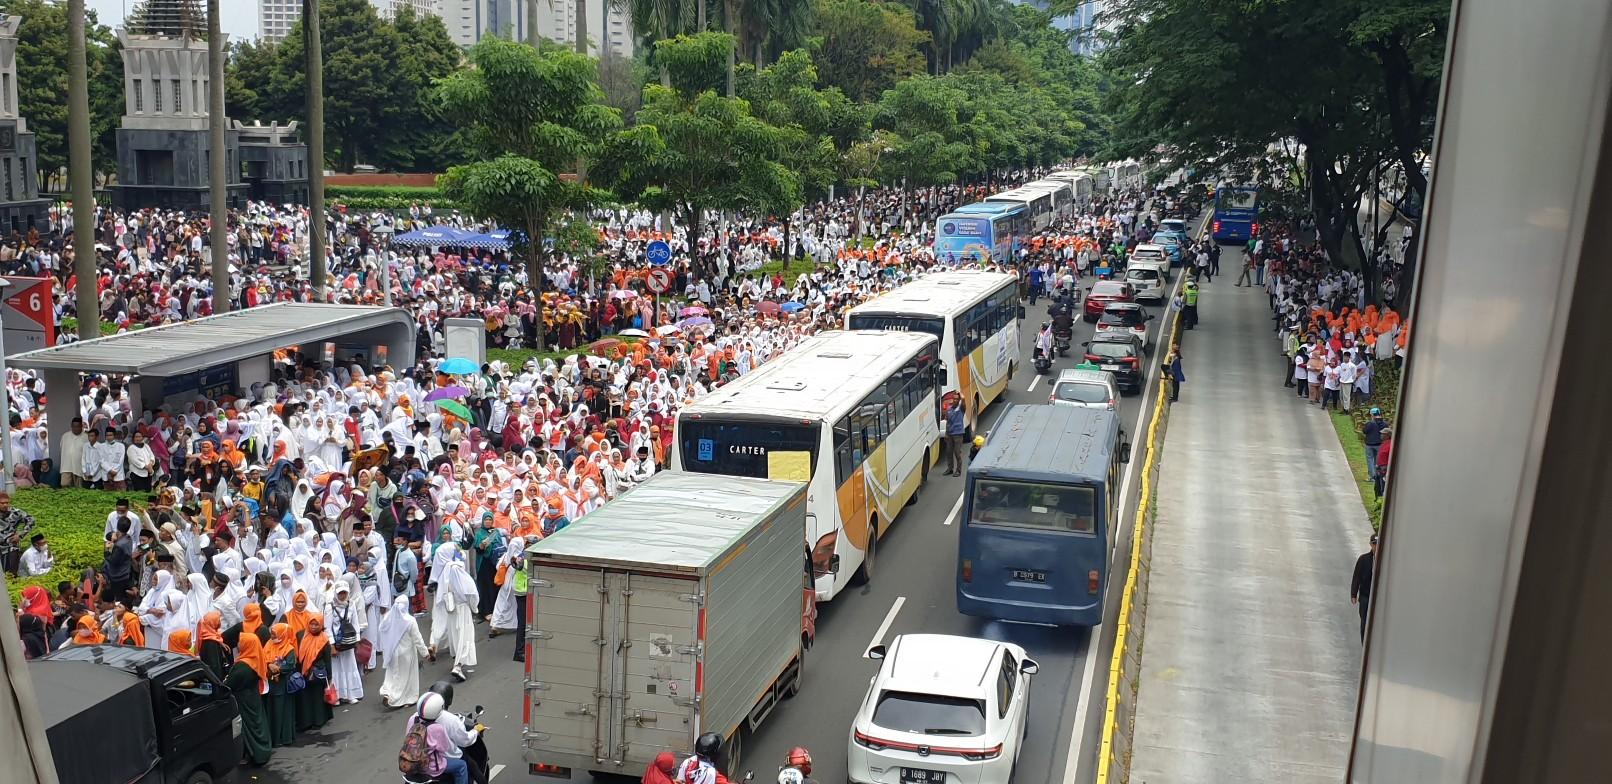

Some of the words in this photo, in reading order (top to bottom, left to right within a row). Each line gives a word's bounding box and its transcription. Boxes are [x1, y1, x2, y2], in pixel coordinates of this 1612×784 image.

[29, 292, 41, 312] 6
[700, 443, 711, 452] 03
[729, 445, 765, 455] CARTER
[901, 768, 907, 777] B
[911, 769, 926, 780] 1689
